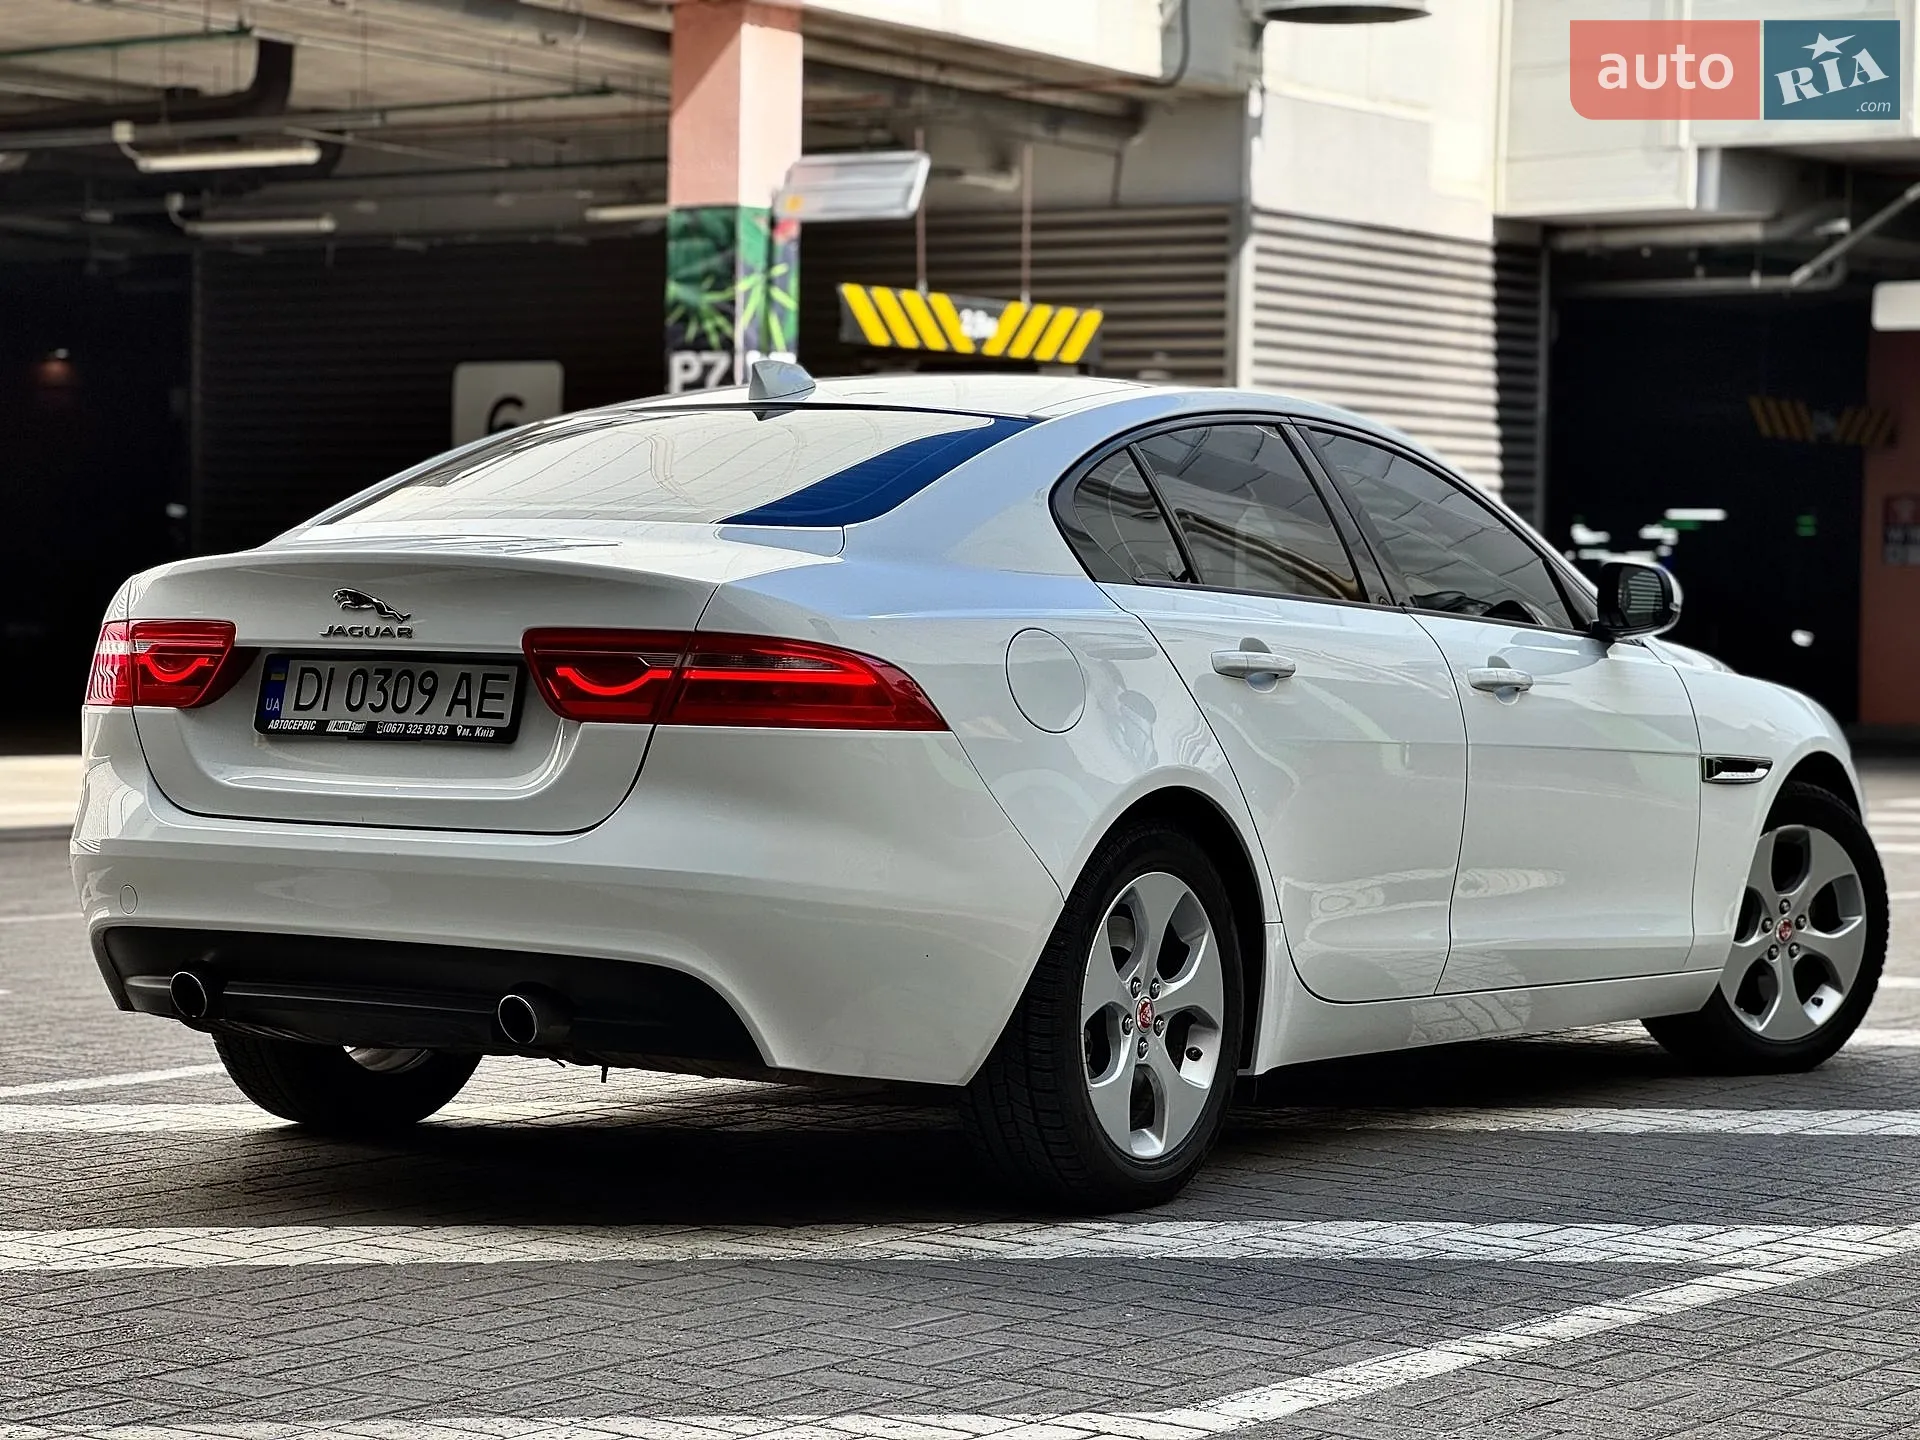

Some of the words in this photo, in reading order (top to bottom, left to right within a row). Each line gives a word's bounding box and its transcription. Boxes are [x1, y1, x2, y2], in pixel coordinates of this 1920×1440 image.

[320, 625, 414, 639] JAGUAR
[293, 666, 336, 712] DI
[345, 667, 439, 716] 0309
[445, 672, 510, 720] AE
[265, 697, 280, 712] UA
[268, 719, 317, 731] АВТОСЕРВІС
[383, 723, 405, 734] (067)
[406, 724, 423, 735] 325
[424, 725, 436, 736] 93
[437, 725, 449, 736] 93
[474, 726, 495, 738] Київ
